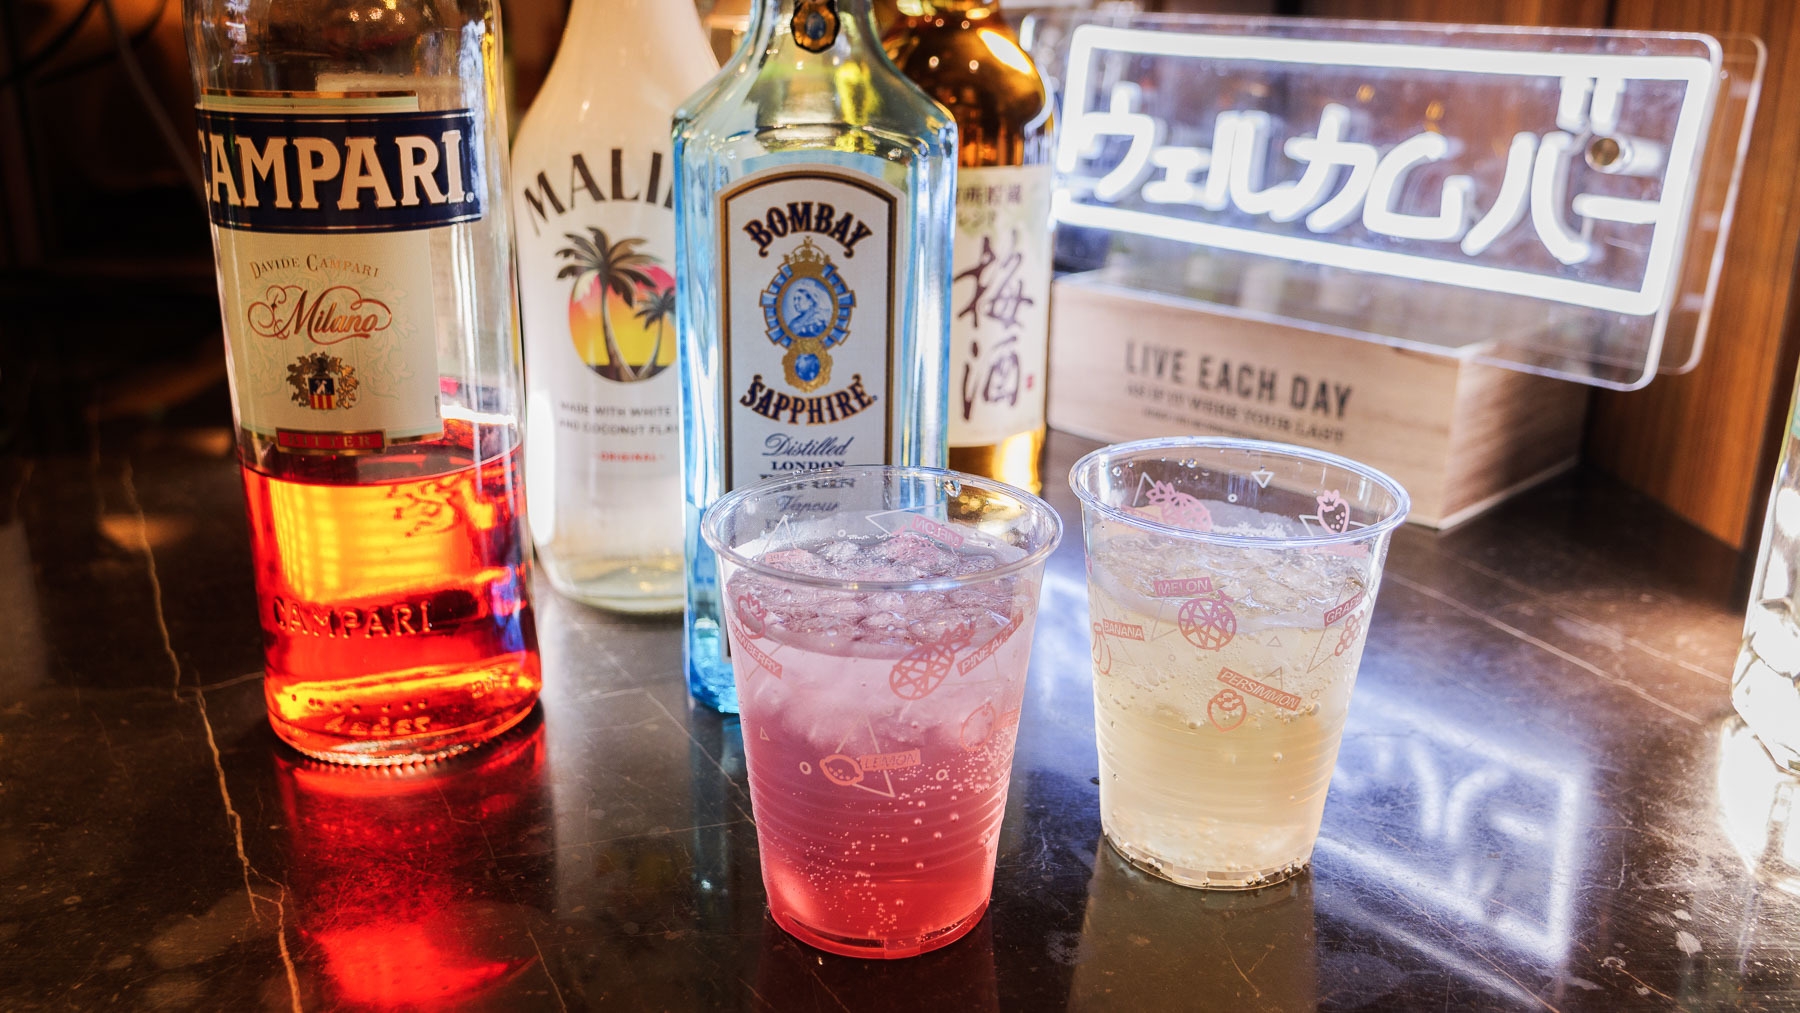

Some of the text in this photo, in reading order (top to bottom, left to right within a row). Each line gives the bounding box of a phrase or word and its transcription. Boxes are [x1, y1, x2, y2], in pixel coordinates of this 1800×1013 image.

[523, 148, 673, 237] MALI
[742, 201, 873, 259] BOMBAY
[250, 254, 380, 280] DAVIDE CAMPARI
[248, 284, 392, 345] Milano
[953, 228, 1034, 421] 梅酒
[1125, 340, 1187, 383] LIVE
[1197, 355, 1277, 402] EACH
[1290, 373, 1353, 420] DAY
[595, 405, 626, 416] WITH
[631, 407, 672, 416] WHITE
[740, 373, 873, 426] SAPPHIRE
[288, 434, 373, 449] BITTER
[583, 423, 645, 434] COCONUT
[762, 433, 855, 457] Distilled
[1158, 578, 1211, 596] MELON
[272, 595, 432, 639] CAMPARI
[1103, 620, 1143, 639] BANANA
[1220, 669, 1299, 710] PERSIMMON
[864, 752, 918, 769] LEMON
